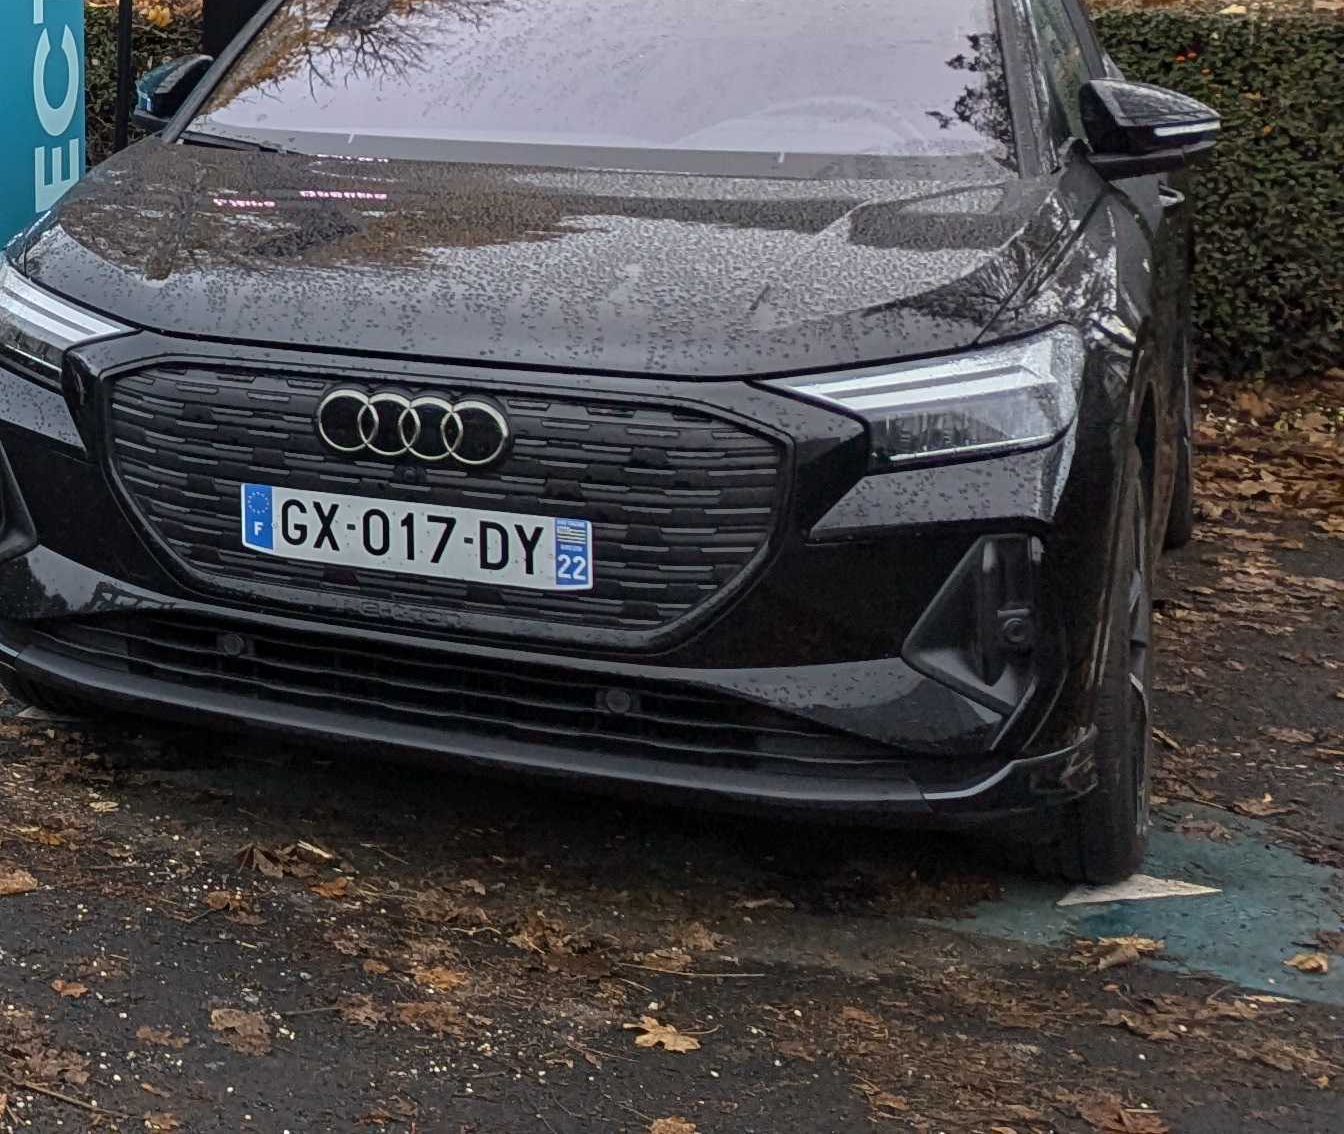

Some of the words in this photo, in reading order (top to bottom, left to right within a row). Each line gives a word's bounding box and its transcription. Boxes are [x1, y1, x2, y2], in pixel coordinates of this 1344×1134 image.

[253, 521, 263, 536] F
[280, 498, 544, 575] GX-017-DY
[557, 554, 587, 581] 22
